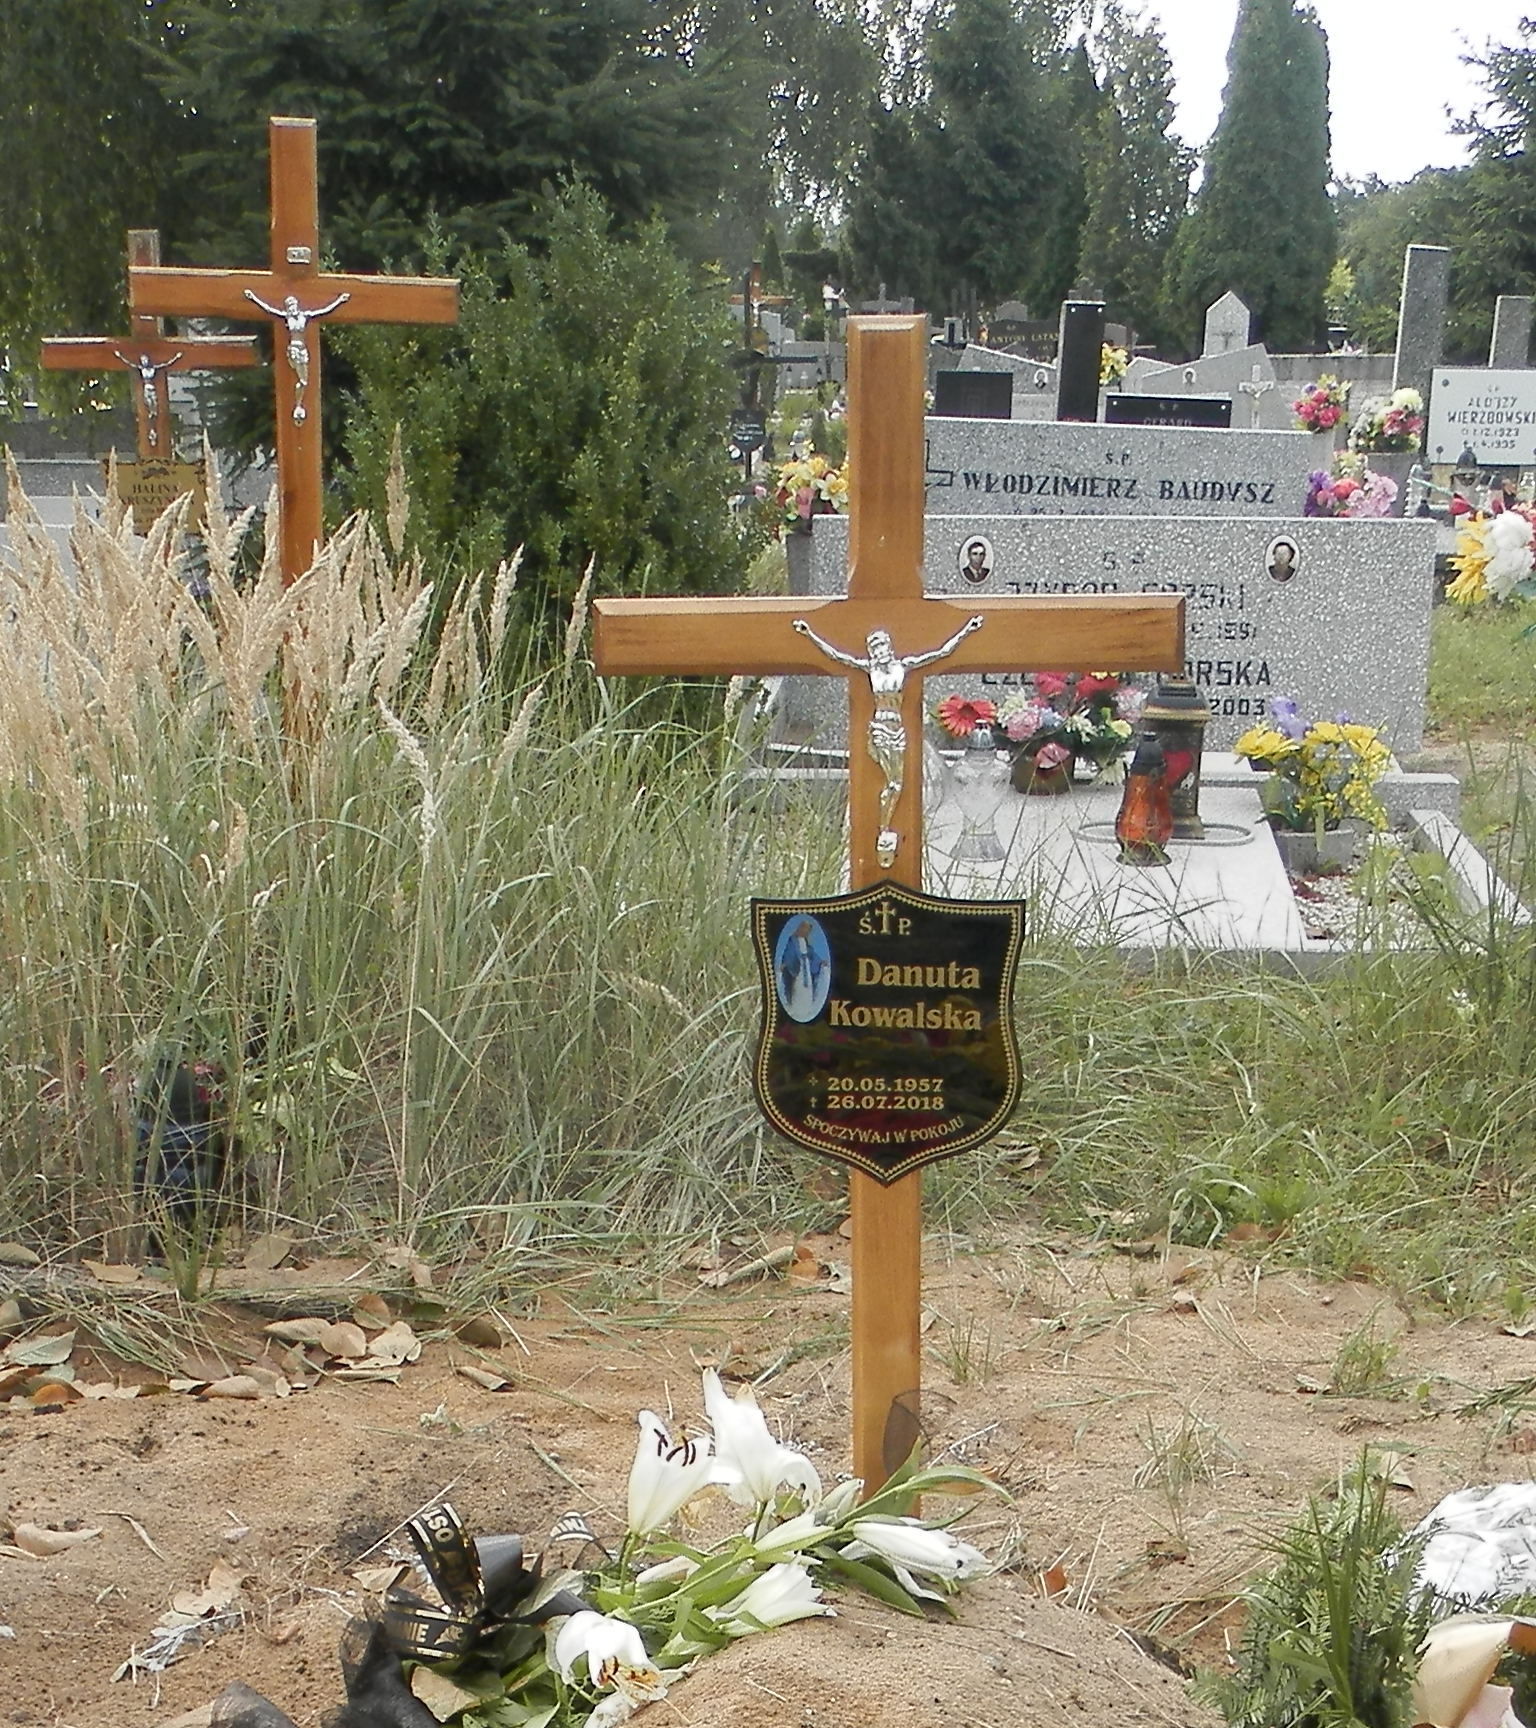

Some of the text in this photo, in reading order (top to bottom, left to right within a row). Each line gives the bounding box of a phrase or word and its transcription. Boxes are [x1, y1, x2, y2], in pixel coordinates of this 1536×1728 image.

[962, 471, 1276, 505] WŁODZIMIERZ BAUDYSZ
[856, 957, 982, 989] Danuta
[828, 999, 982, 1031] Kowalska
[826, 1076, 944, 1093] 20.05.1957
[826, 1094, 945, 1111] 26.07.2018
[802, 1113, 965, 1144] SPOCZYWAJ W POKOJU
